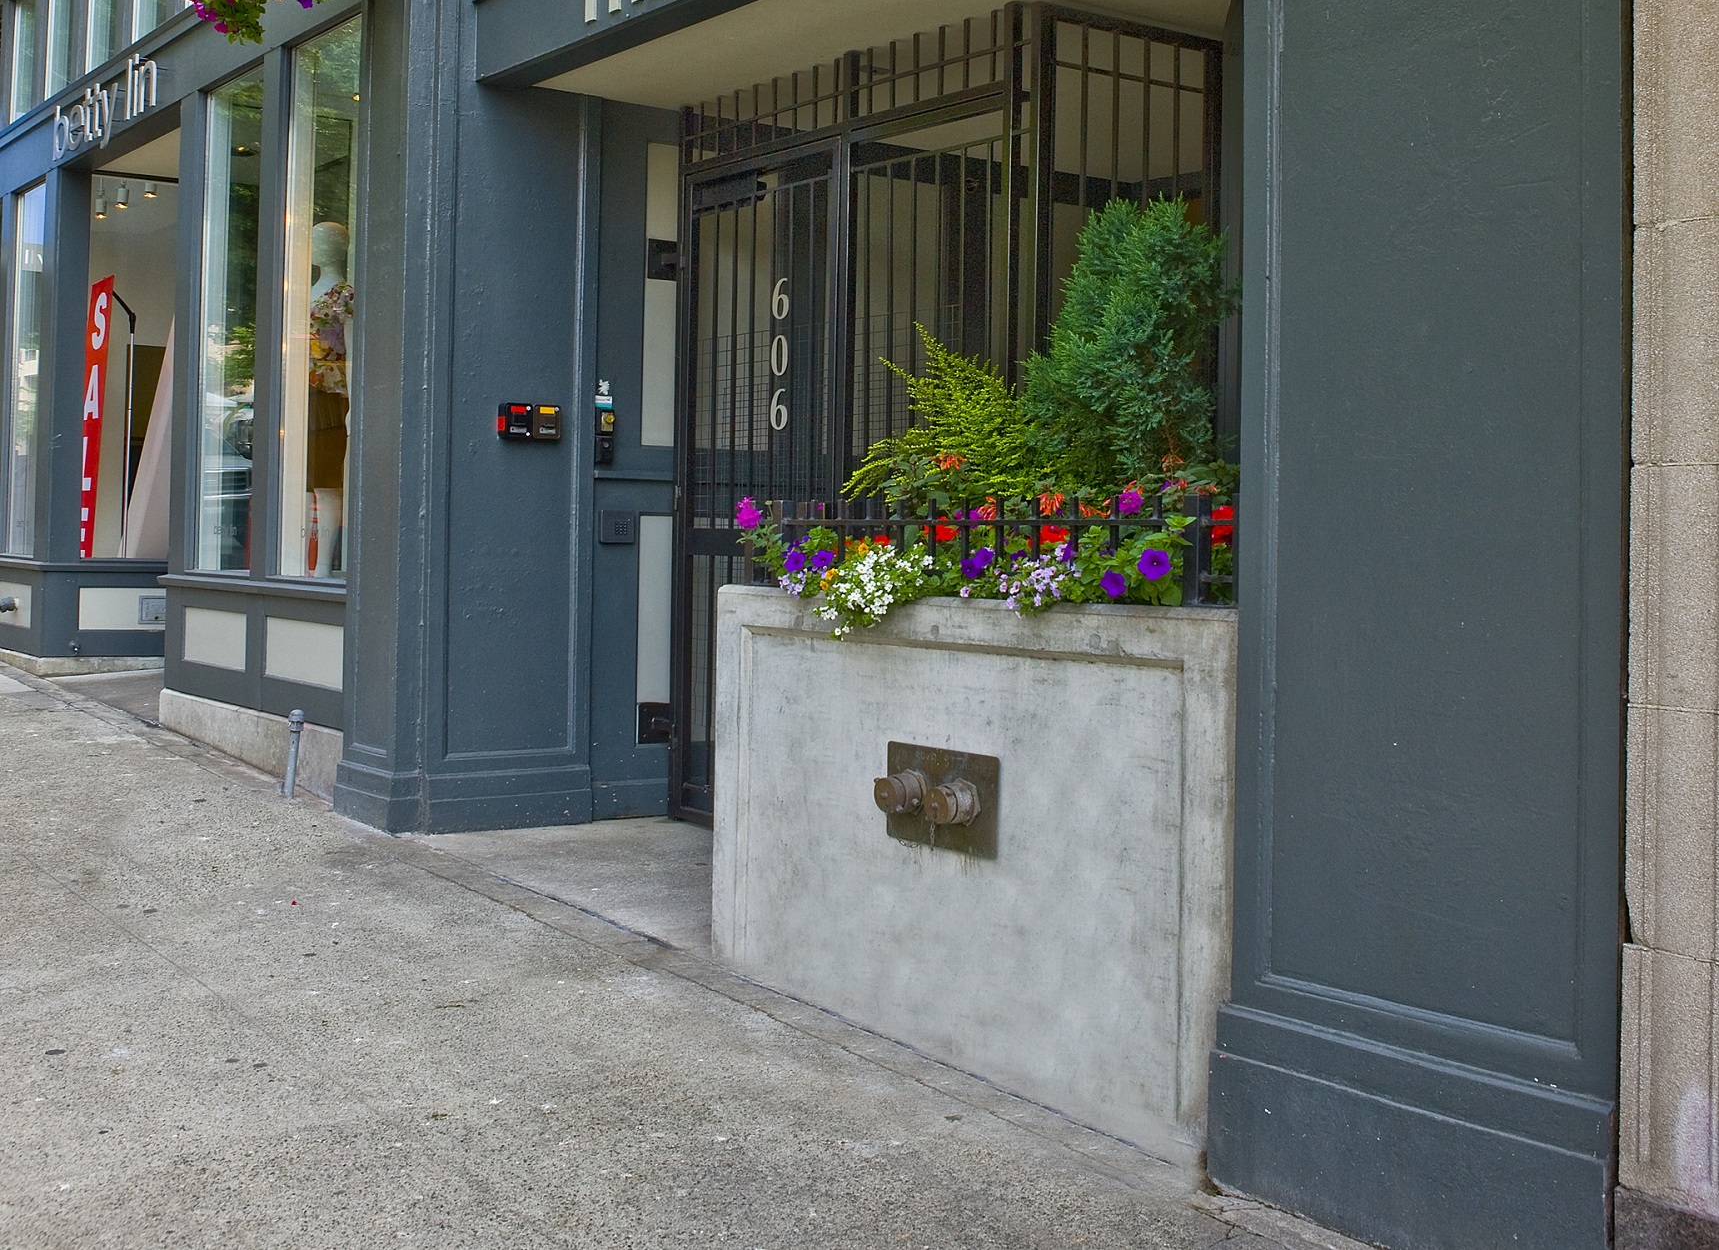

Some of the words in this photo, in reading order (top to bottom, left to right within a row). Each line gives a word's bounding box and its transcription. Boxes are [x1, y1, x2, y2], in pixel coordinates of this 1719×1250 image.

[52, 82, 119, 162] betty
[124, 53, 158, 121] lin
[769, 278, 790, 431] 606
